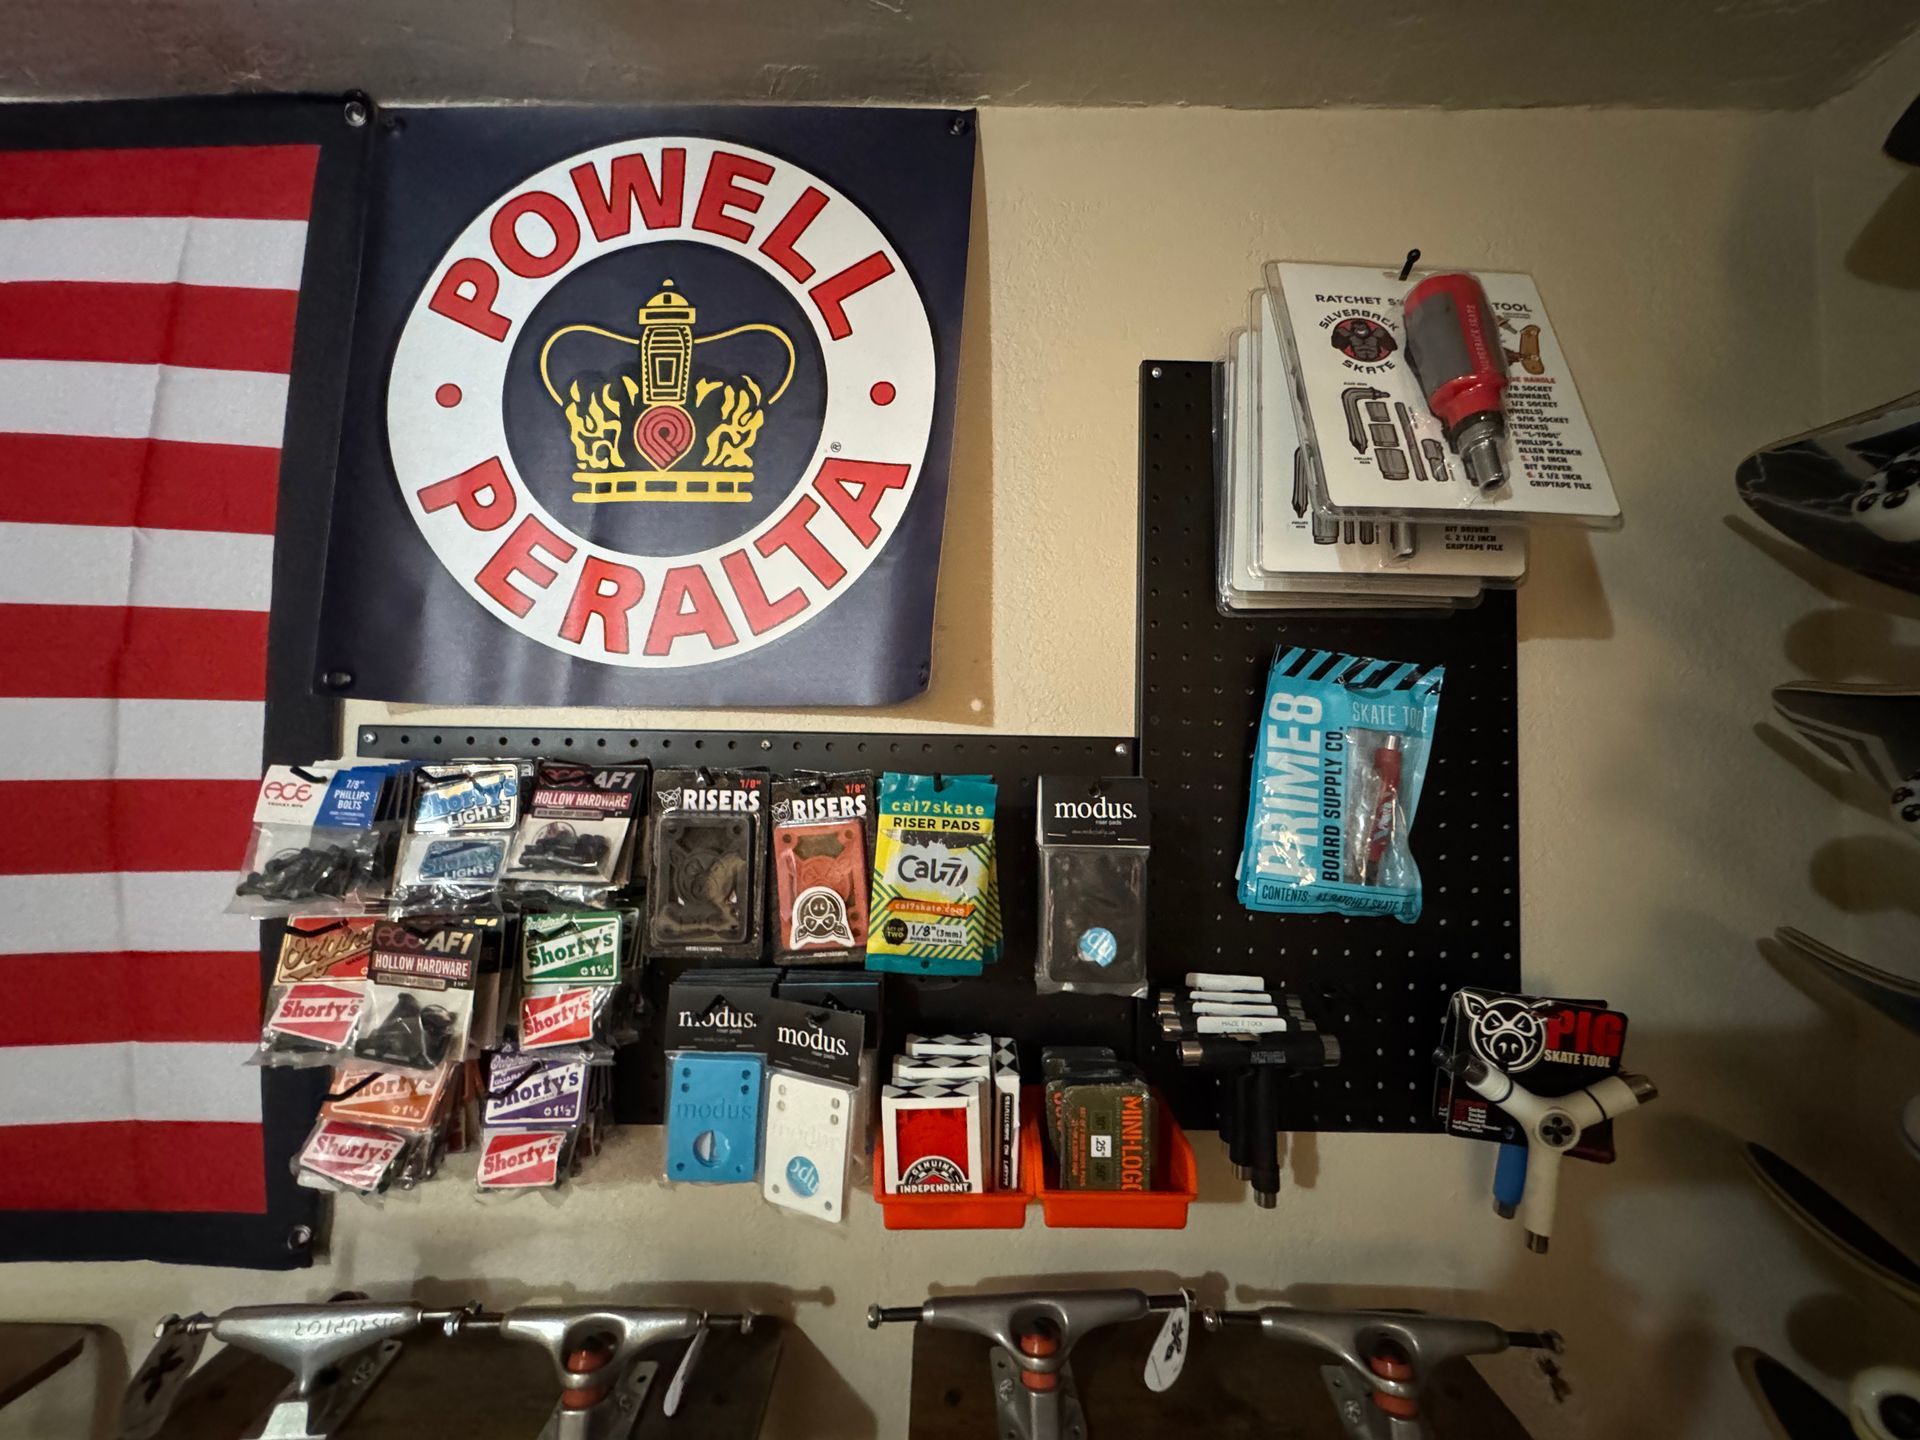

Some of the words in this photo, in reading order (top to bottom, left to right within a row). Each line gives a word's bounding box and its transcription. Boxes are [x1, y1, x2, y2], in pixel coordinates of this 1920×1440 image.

[428, 147, 896, 343] POWELL
[1315, 293, 1382, 306] RATCHET
[1493, 302, 1533, 313] TOOL
[1318, 308, 1400, 332] SILVERBACK
[1341, 359, 1397, 375] SKATE
[1510, 423, 1549, 431] (TRUCKS)
[1515, 439, 1554, 447] PHILLIPS
[1547, 448, 1582, 456] WRENCH
[1530, 480, 1572, 489] GRIPTAPE
[1574, 482, 1592, 490] FILE
[416, 456, 912, 657] PERALTA
[1445, 543, 1484, 551] GRIPTAPE
[1352, 702, 1396, 726] SKATE
[1402, 705, 1429, 734] TOOL
[1325, 726, 1344, 753] CO.
[334, 789, 371, 801] PHILLIPS
[740, 779, 762, 790] 1/8"
[845, 783, 866, 794] 1/8"
[1256, 692, 1324, 885] PRIME8
[1323, 757, 1343, 820] SUPPLY
[337, 800, 362, 810] BOLTS
[534, 791, 576, 806] HOLLOW
[575, 793, 630, 808] HARDWARE
[682, 788, 760, 812] RISERS
[791, 795, 868, 820] RISERS
[891, 799, 985, 817] cal7skate
[1054, 796, 1138, 819] modus.
[447, 800, 511, 828] LIGHTS
[893, 817, 937, 830] RISER
[943, 818, 981, 832] PADS
[1323, 824, 1341, 882] BOARD
[444, 863, 495, 879] LIGHTS
[1262, 885, 1311, 903] CONTENTS:
[425, 930, 474, 955] AF1
[936, 929, 963, 939] (3mm)
[527, 928, 614, 969] Shorty's
[375, 954, 415, 971] HOLLOW
[416, 957, 469, 977] HARDWARE
[280, 999, 361, 1021] Shorty's
[523, 997, 591, 1036] Shorty's
[777, 1026, 850, 1056] modus.
[1547, 1010, 1623, 1057] PIG
[1543, 1049, 1581, 1065] SKATE
[1582, 1053, 1611, 1069] TOOL
[313, 1136, 393, 1165] Shorty's
[484, 1138, 558, 1176] Shorty's
[911, 1160, 955, 1176] GENUINE
[900, 1183, 969, 1194] INDEPENDENT
